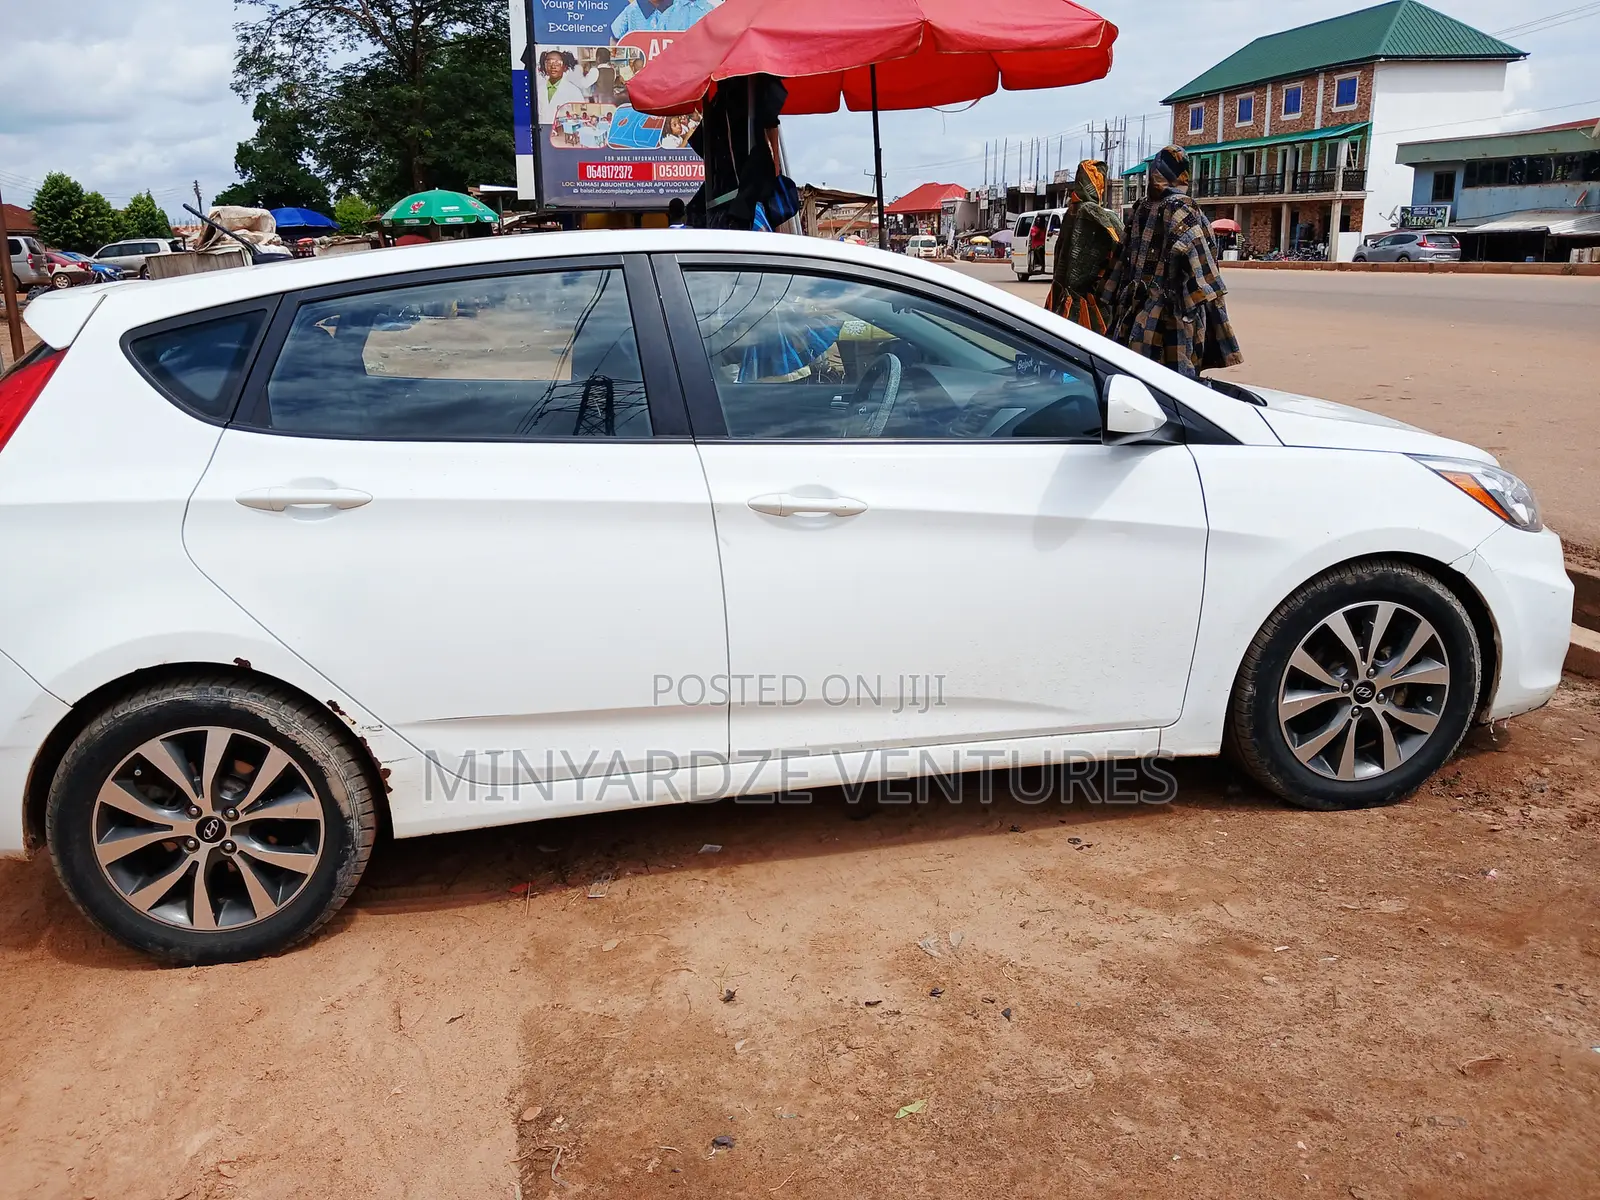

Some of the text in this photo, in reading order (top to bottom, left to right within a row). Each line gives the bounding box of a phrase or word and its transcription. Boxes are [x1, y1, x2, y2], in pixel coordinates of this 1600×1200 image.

[541, 0, 609, 10] Young Minds
[567, 12, 585, 21] For
[586, 165, 633, 179] 0549172372
